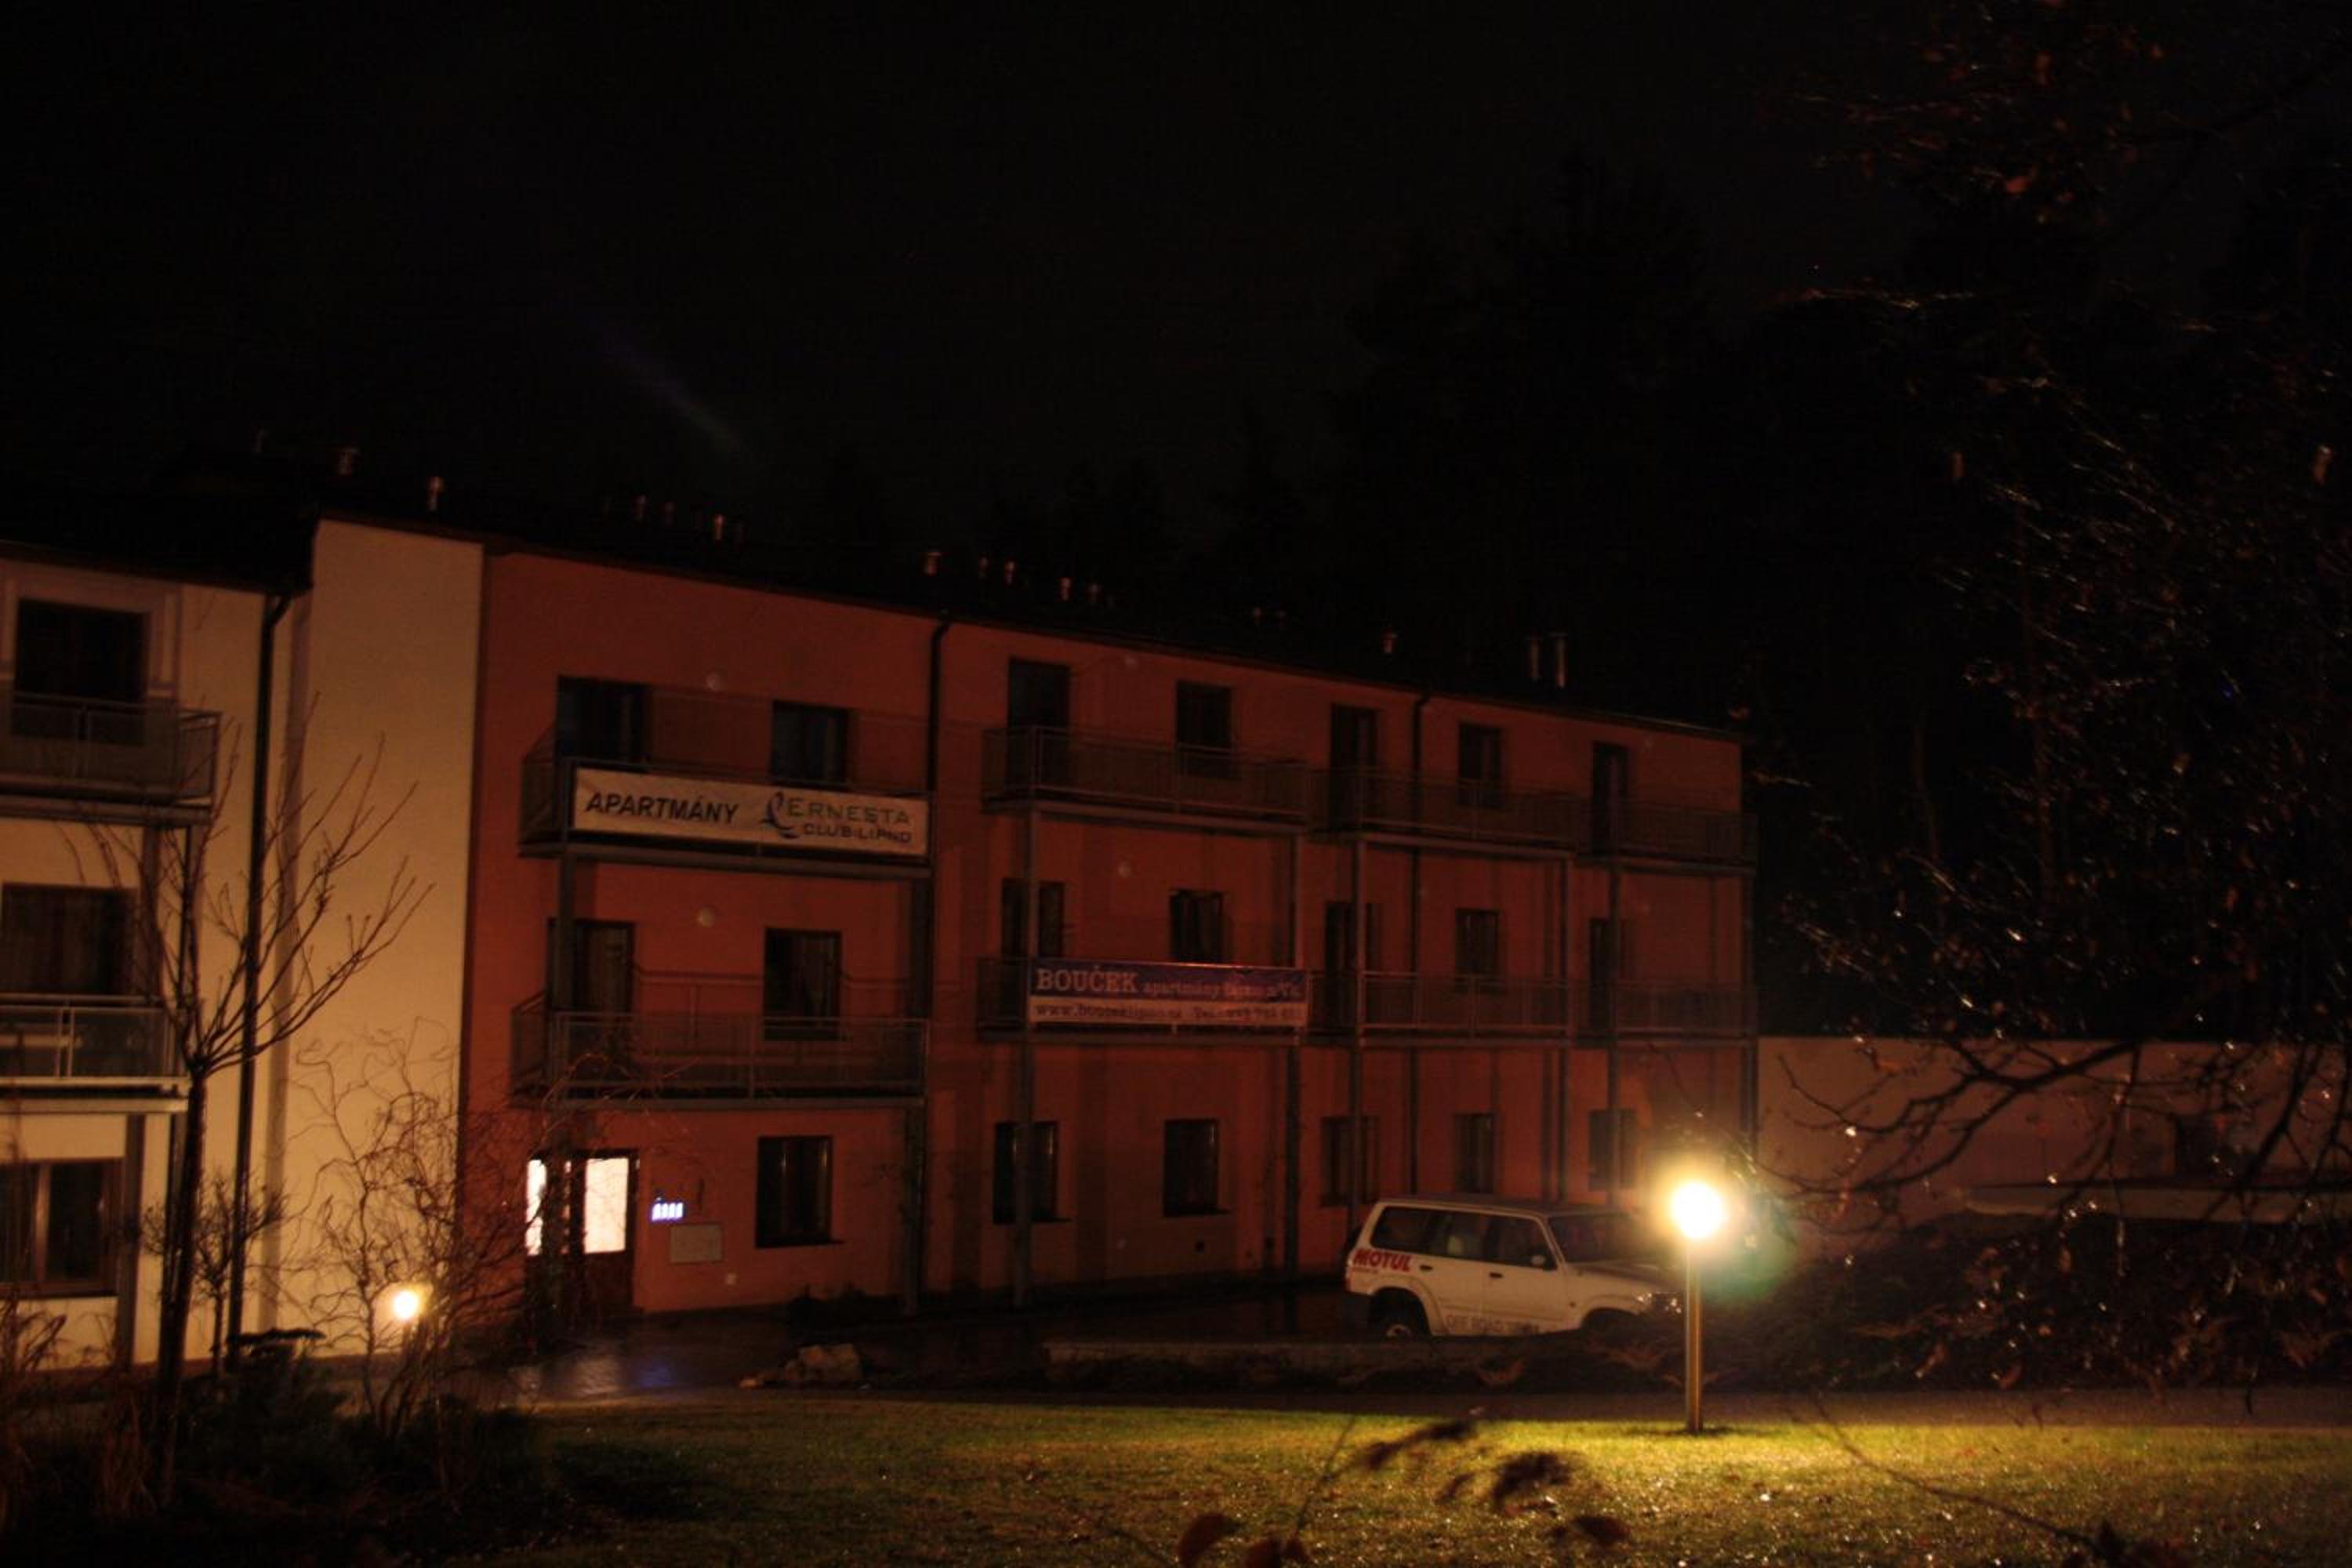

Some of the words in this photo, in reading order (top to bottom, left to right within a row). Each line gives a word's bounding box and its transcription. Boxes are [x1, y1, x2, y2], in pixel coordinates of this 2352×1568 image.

[586, 790, 739, 822] APARTMÁNY
[1036, 966, 1138, 993] BOUČEK
[1353, 1248, 1411, 1272] MOTUL
